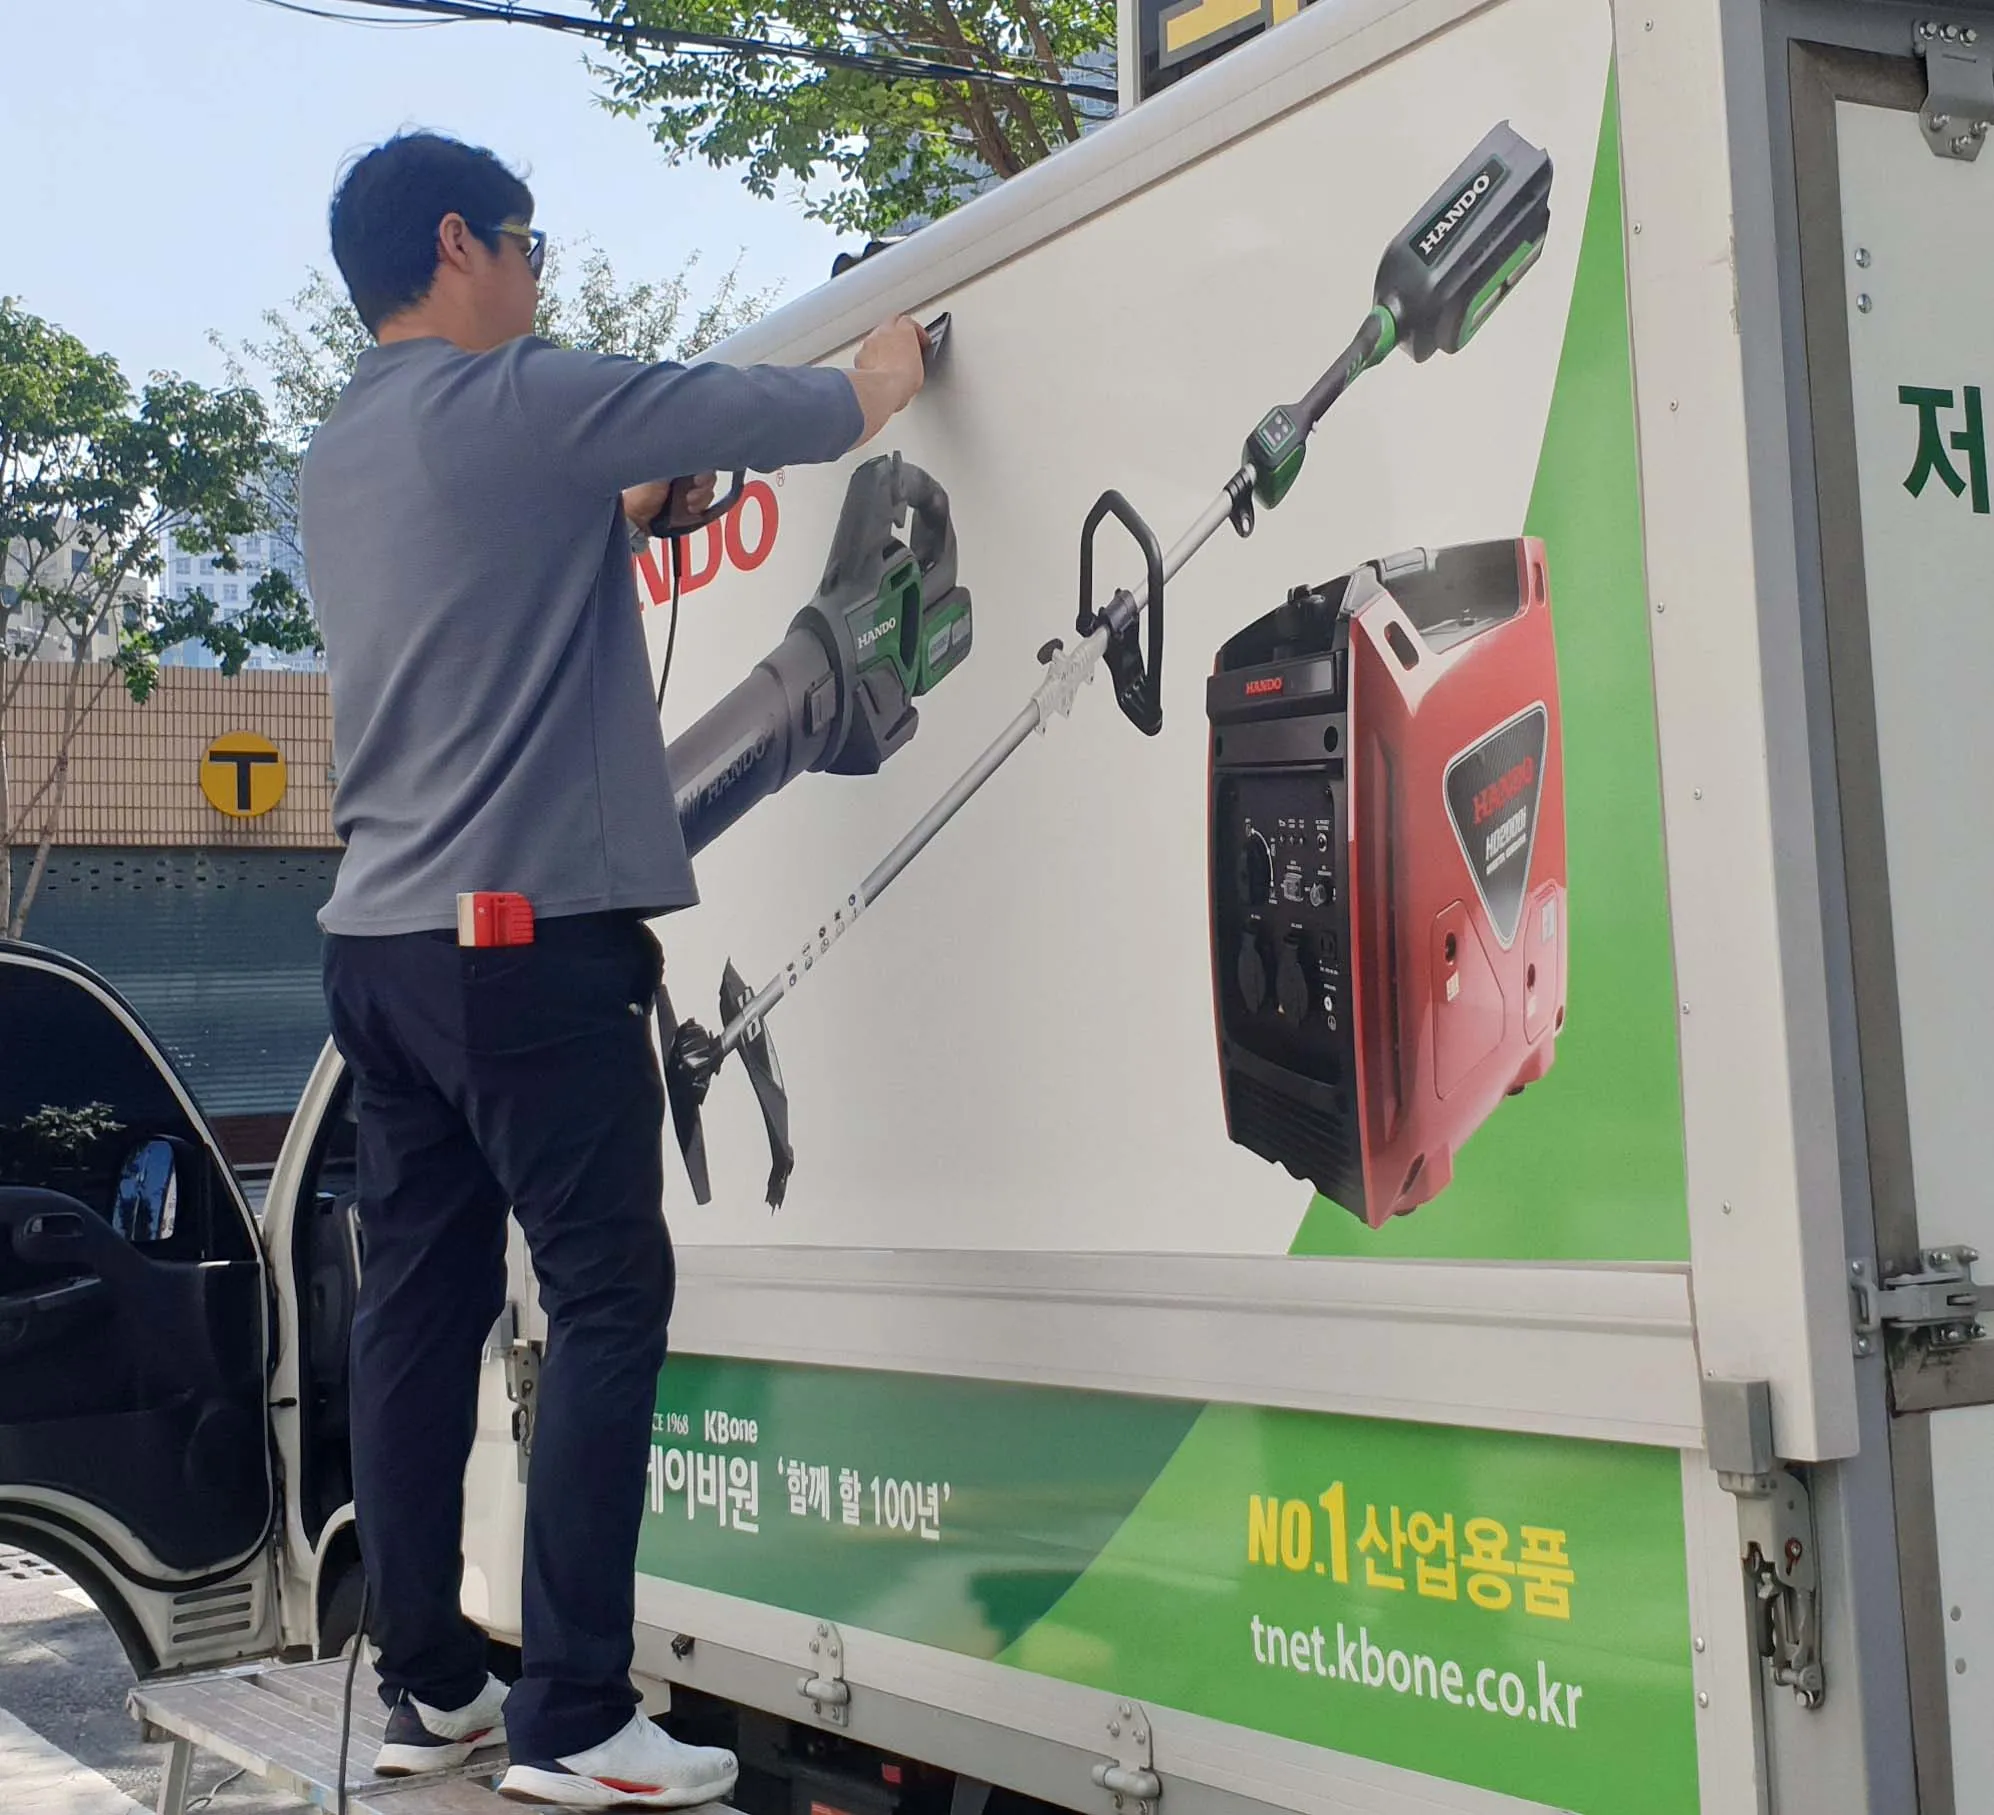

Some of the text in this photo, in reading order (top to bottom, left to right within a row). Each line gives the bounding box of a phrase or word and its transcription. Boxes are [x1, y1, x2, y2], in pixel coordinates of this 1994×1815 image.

[1418, 172, 1490, 256] HANDO
[1898, 385, 1991, 514] 저
[632, 480, 779, 612] NDO
[857, 617, 897, 650] HANDO
[209, 750, 279, 810] T
[666, 1411, 690, 1436] 1968
[704, 1408, 759, 1444] KBone
[838, 1466, 862, 1527] 할
[1356, 1503, 1576, 1621] 산업용품
[1250, 1614, 1584, 1730] tnet.kbone.co.kr
